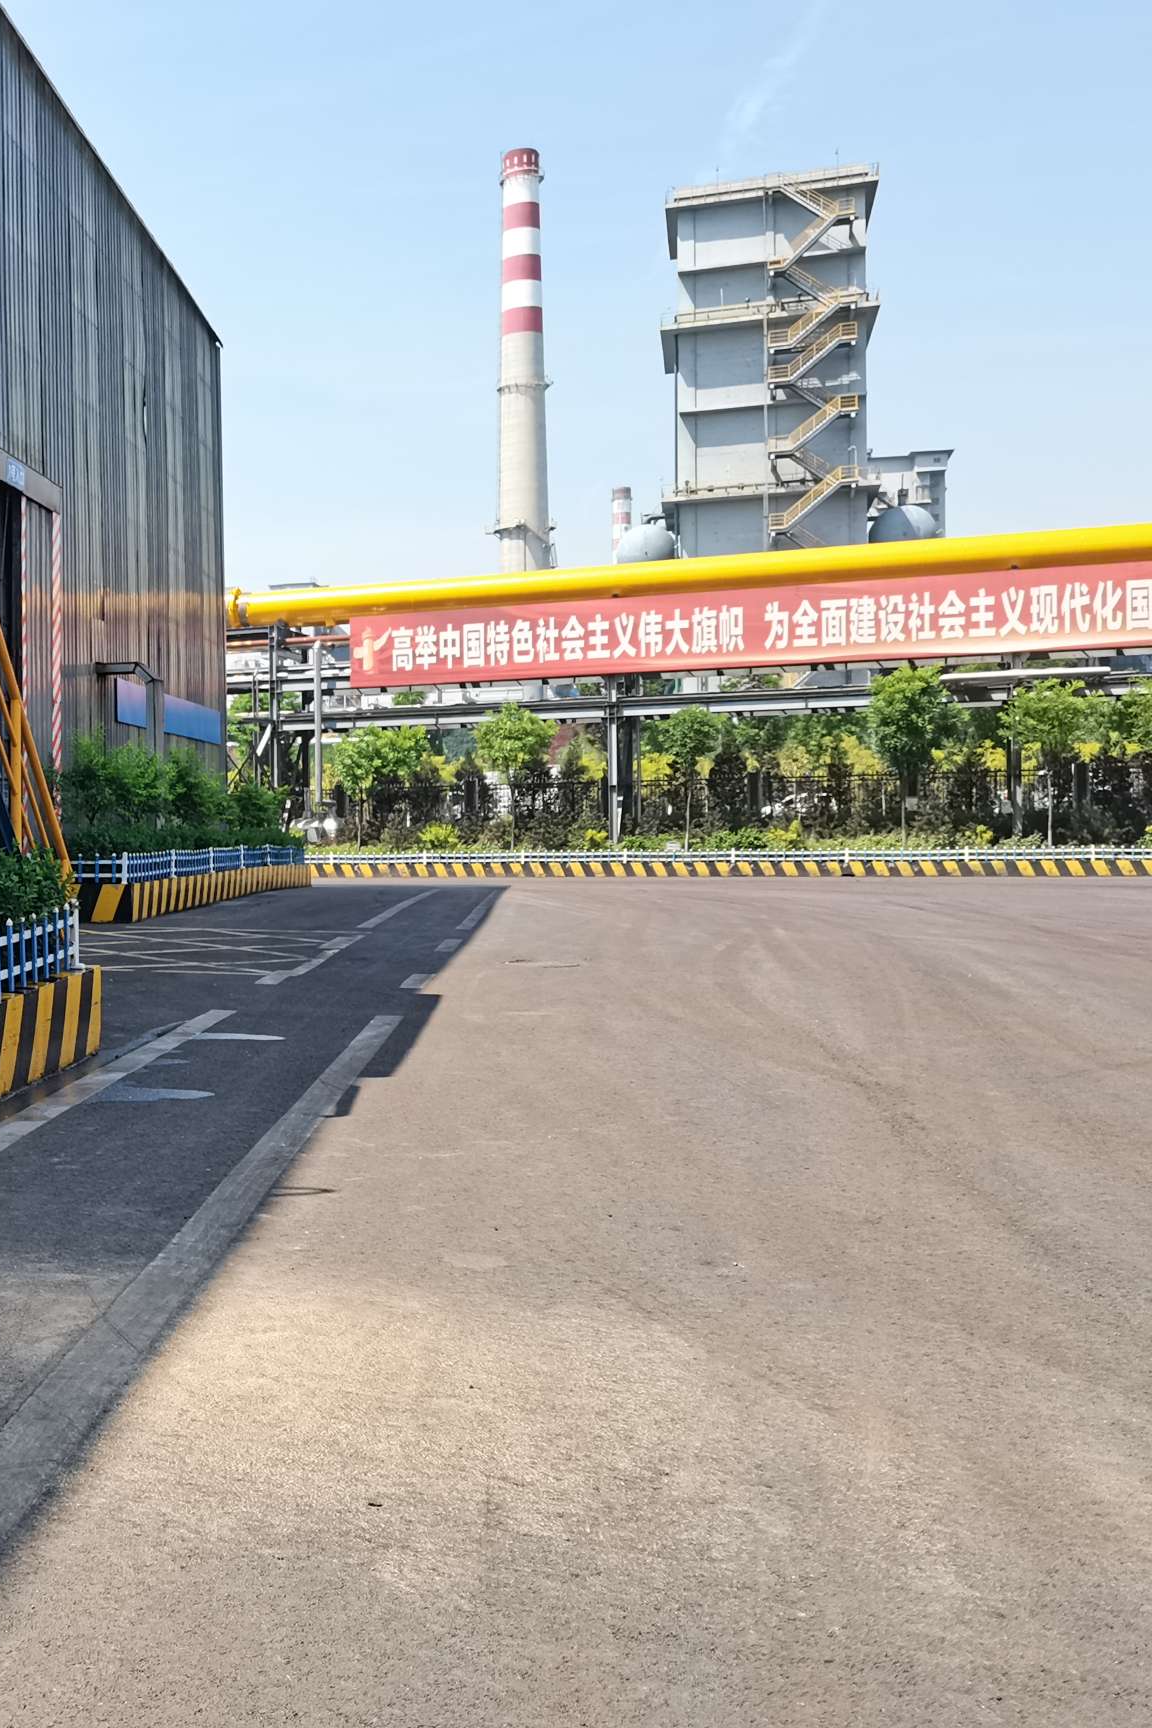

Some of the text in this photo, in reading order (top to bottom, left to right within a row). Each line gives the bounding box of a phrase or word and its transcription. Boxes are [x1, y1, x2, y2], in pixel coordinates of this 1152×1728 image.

[391, 579, 1152, 672] 高举中国特色社会主义伟大旗帜 为全面建设社会主义现代化国
